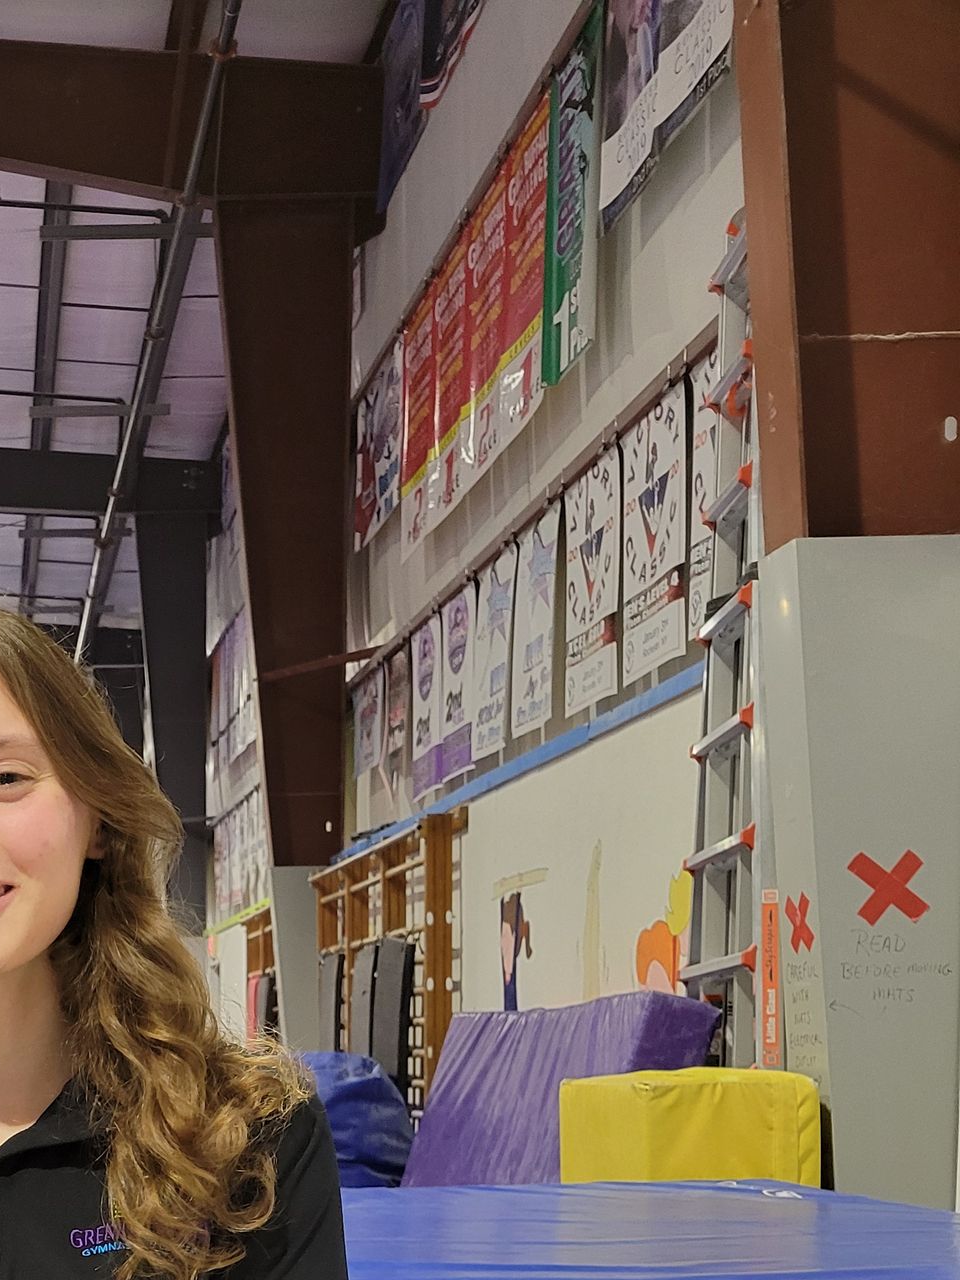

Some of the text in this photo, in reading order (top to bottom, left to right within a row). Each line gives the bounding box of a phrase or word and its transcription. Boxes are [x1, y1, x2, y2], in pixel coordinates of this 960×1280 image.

[850, 927, 907, 957] READ
[786, 960, 820, 984] CAREFUL
[840, 961, 901, 980] BEFORE
[872, 987, 915, 1003] MATS
